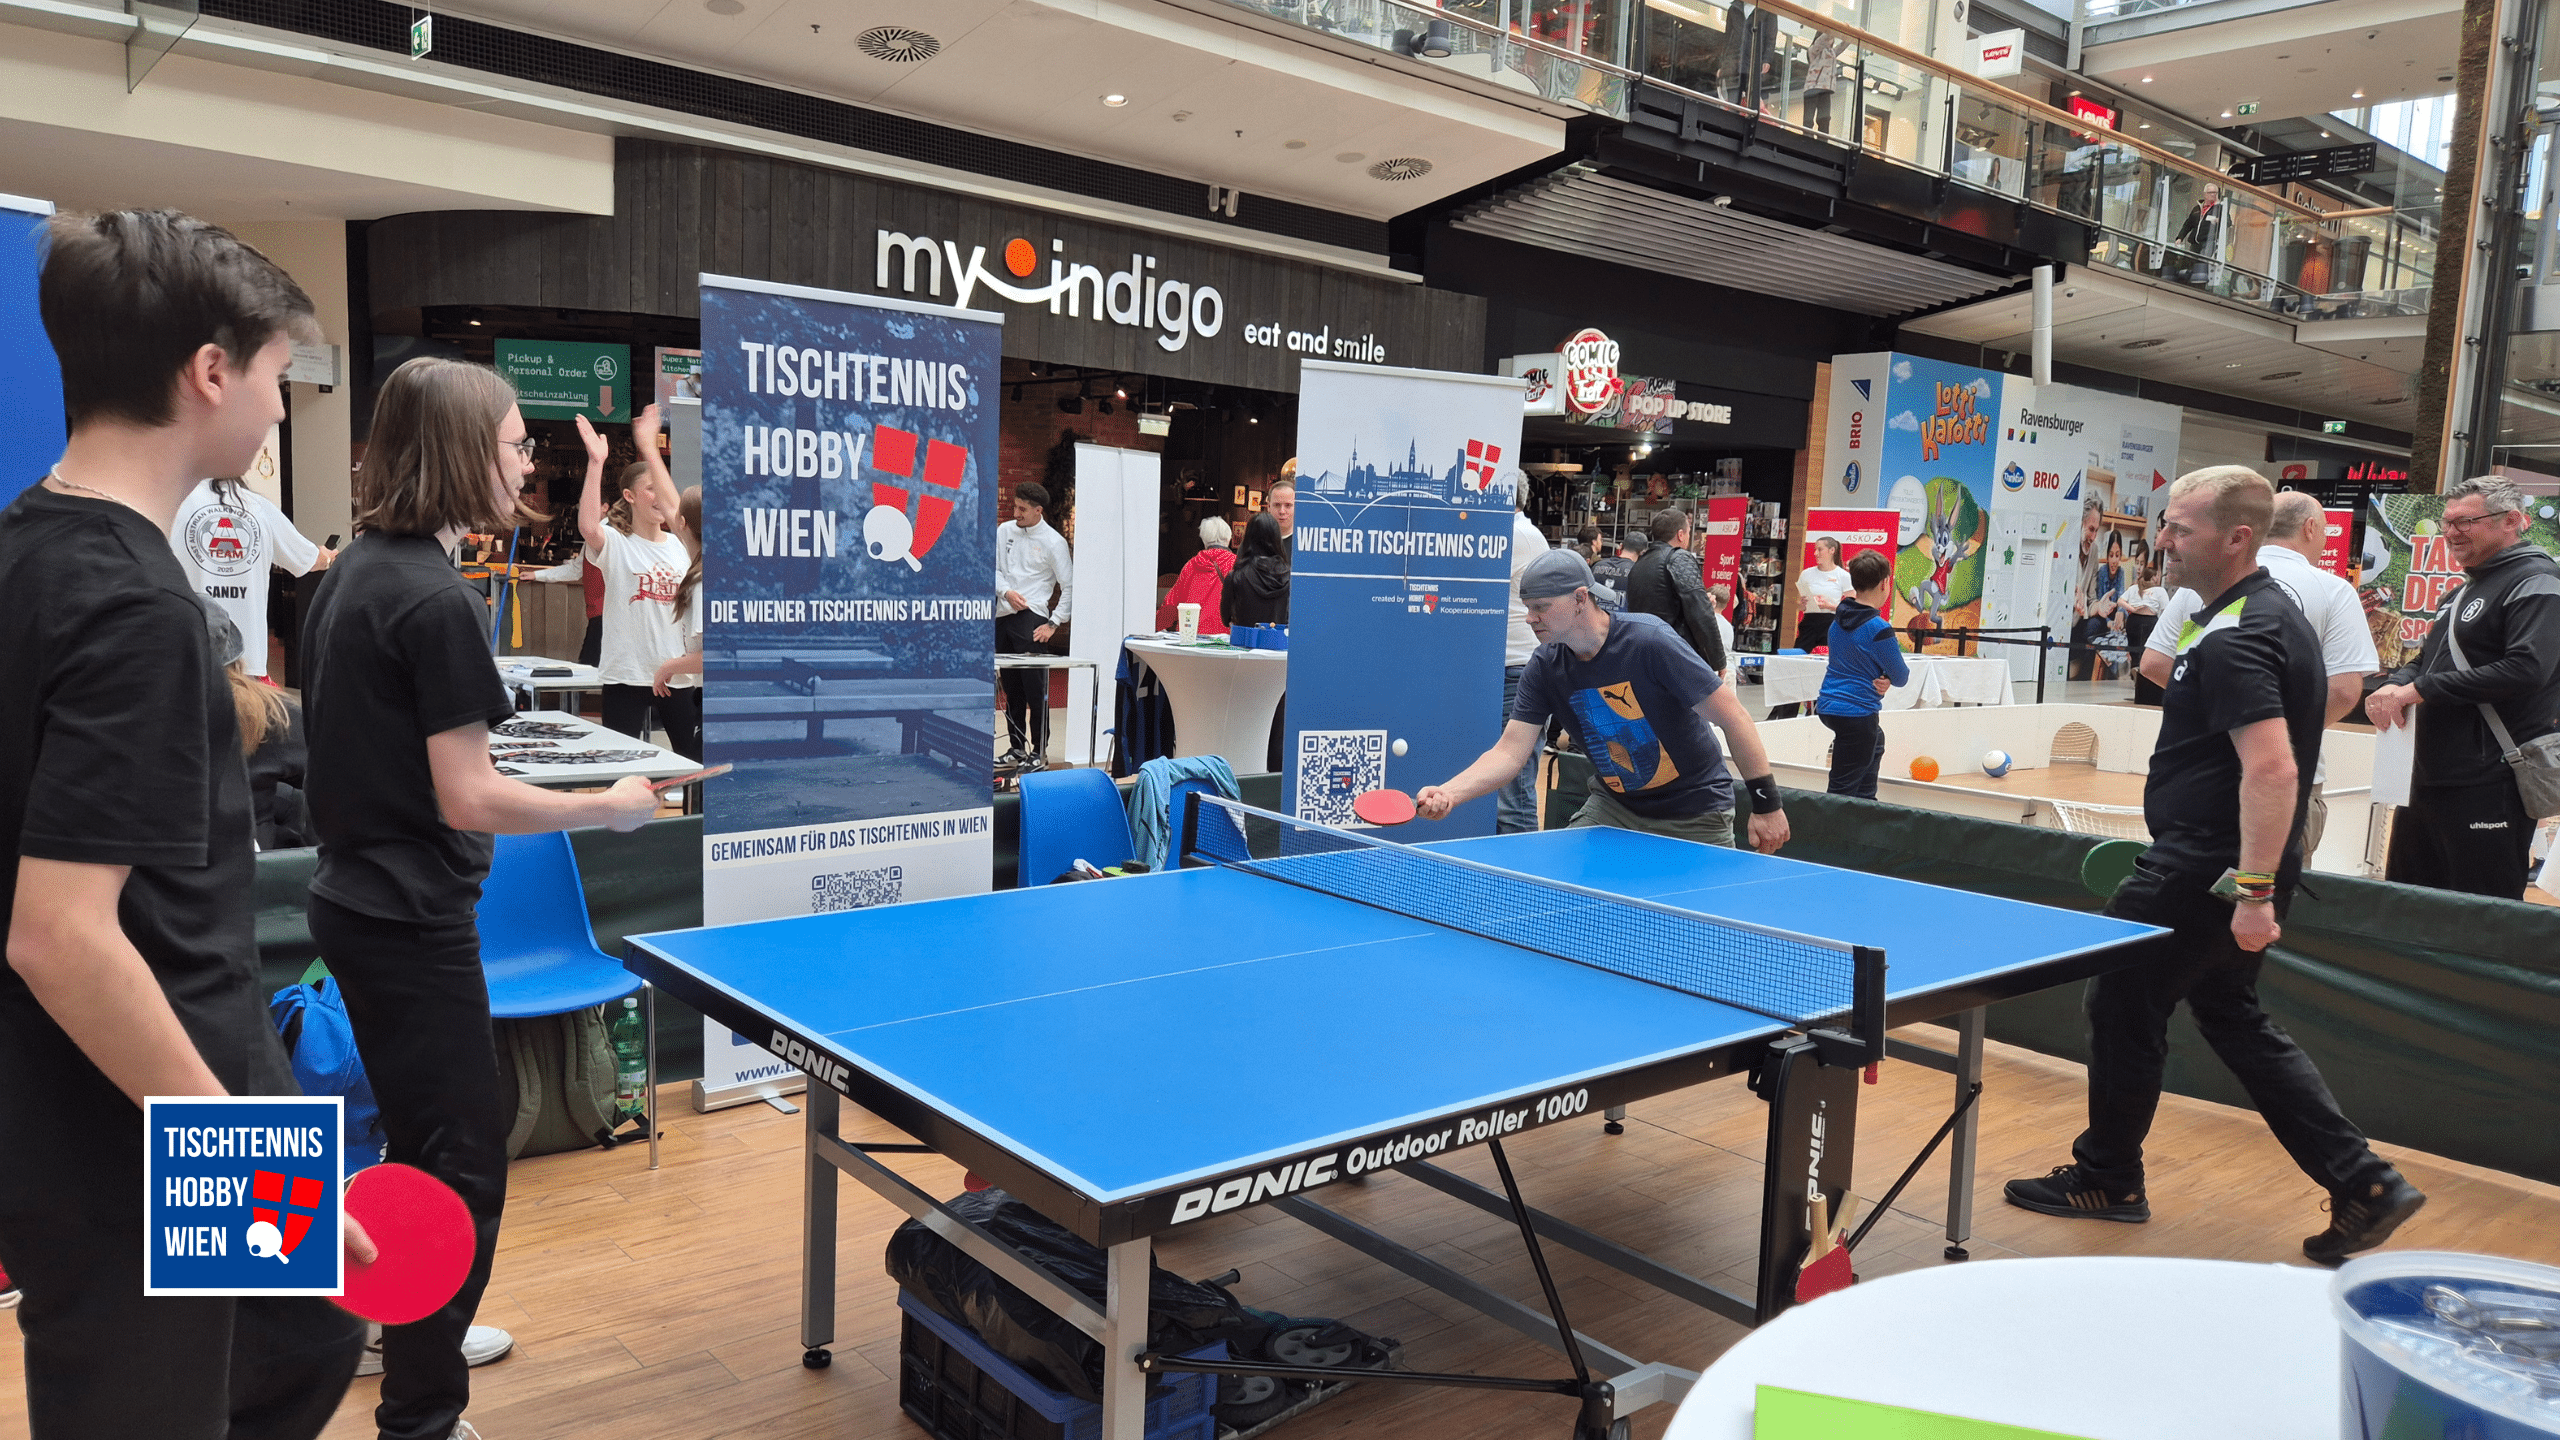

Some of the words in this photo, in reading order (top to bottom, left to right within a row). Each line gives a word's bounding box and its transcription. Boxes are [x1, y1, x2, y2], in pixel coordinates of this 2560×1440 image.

[2250, 163, 2257, 181] 1
[877, 229, 986, 309] my
[1050, 238, 1224, 352] indigo
[1244, 320, 1281, 347] eat
[1287, 325, 1329, 355] and
[1332, 331, 1386, 364] smile
[508, 353, 542, 365] Pickup
[548, 354, 554, 364] &
[662, 354, 683, 363] Super
[1563, 339, 1620, 370] COMIC
[508, 365, 552, 377] Personal
[558, 368, 588, 378] Order
[741, 341, 968, 411] TISCHTENNIS
[517, 388, 589, 401] tscheinzahlung
[1935, 381, 1977, 420] Lotti
[1629, 395, 1665, 416] POP
[1665, 398, 1687, 418] UP
[1687, 402, 1732, 425] STORE
[2020, 408, 2085, 436] Ravensburger
[1849, 411, 1863, 449] BRIO
[1921, 412, 1990, 462] Karotti
[744, 425, 866, 480] HOBBY
[2033, 471, 2060, 490] BRIO
[189, 511, 206, 544] AUSTRIAN
[743, 507, 836, 558] WIEN
[209, 549, 244, 560] TEAM
[1297, 526, 1363, 554] WIENER
[1368, 529, 1475, 558] TISCHTENNIS
[1478, 535, 1508, 559] CUP
[2321, 548, 2338, 557] ort
[1719, 553, 1736, 567] Sport
[2318, 559, 2337, 567] ner
[1409, 583, 1439, 592] TISCHTENNIS
[1717, 570, 1733, 581] seiner
[205, 586, 247, 599] SANDY
[1371, 595, 1395, 603] created
[1396, 595, 1405, 604] by
[1441, 595, 1452, 603] mit
[1453, 596, 1478, 604] unseren
[710, 600, 738, 623] DIE
[742, 600, 805, 622] WIENER
[811, 599, 908, 622] TISCHTENNIS
[911, 599, 992, 621] PLATTFORM
[2469, 821, 2508, 830] uhlsport
[711, 835, 797, 862] GEMEINSAM
[800, 830, 827, 852] FÜR
[830, 829, 856, 849] DAS
[859, 820, 940, 846] TISCHTENNIS
[943, 819, 956, 835] IN
[958, 815, 988, 835] WIEN
[770, 1029, 850, 1091] DONIC
[1170, 1153, 1338, 1225] DONIC
[1346, 1127, 1452, 1176] Outdoor
[1457, 1107, 1528, 1146] Roller
[1535, 1088, 1589, 1124] 1000
